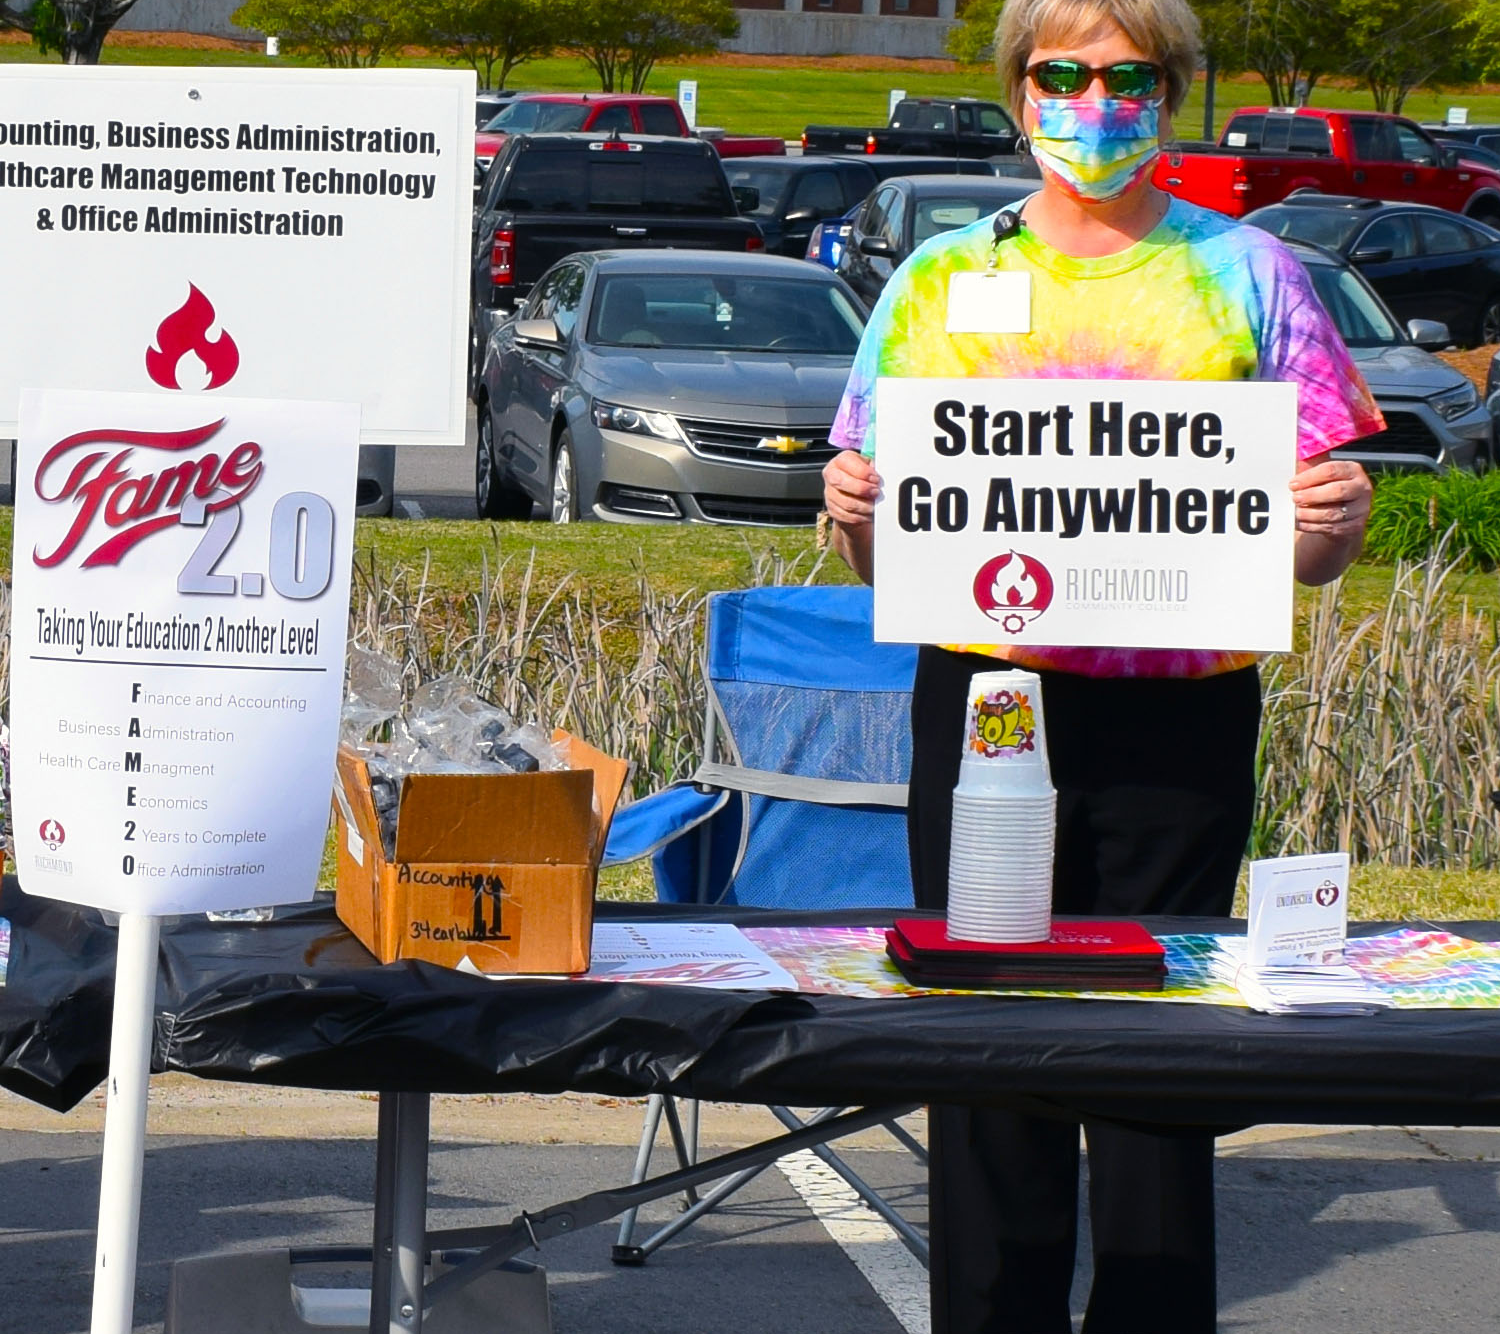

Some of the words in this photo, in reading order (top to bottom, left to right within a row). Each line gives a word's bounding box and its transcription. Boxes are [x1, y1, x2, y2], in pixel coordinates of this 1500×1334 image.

[108, 122, 229, 150] Business
[237, 124, 441, 157] Administration,
[102, 164, 276, 197] Management
[282, 168, 436, 199] Technology
[37, 208, 54, 231] &
[61, 205, 138, 232] Office
[145, 207, 343, 237] Administration
[934, 400, 1073, 456] Start
[1090, 401, 1235, 464] Here,
[32, 415, 263, 569] Fame
[899, 476, 968, 532] Go
[983, 477, 1269, 538] Anywhere
[177, 487, 334, 600] 2.0
[1066, 569, 1188, 602] RICHMOND
[1138, 603, 1187, 611] COLLEGE
[37, 608, 84, 655] Taking
[90, 610, 122, 648] Your
[127, 613, 199, 651] Education
[204, 617, 212, 651] 2
[216, 616, 276, 654] Another
[280, 618, 319, 655] Level
[195, 693, 222, 707] and
[228, 694, 307, 712] Accounting
[58, 719, 121, 736] Business
[128, 717, 235, 742] Administration
[977, 704, 1026, 748] 70's
[39, 752, 82, 769] Health
[87, 756, 121, 772] Care
[124, 752, 215, 777] Managment
[124, 820, 136, 841] 2
[142, 829, 180, 844] Years
[184, 830, 197, 843] to
[202, 830, 267, 846] Complete
[170, 861, 265, 877] Administration
